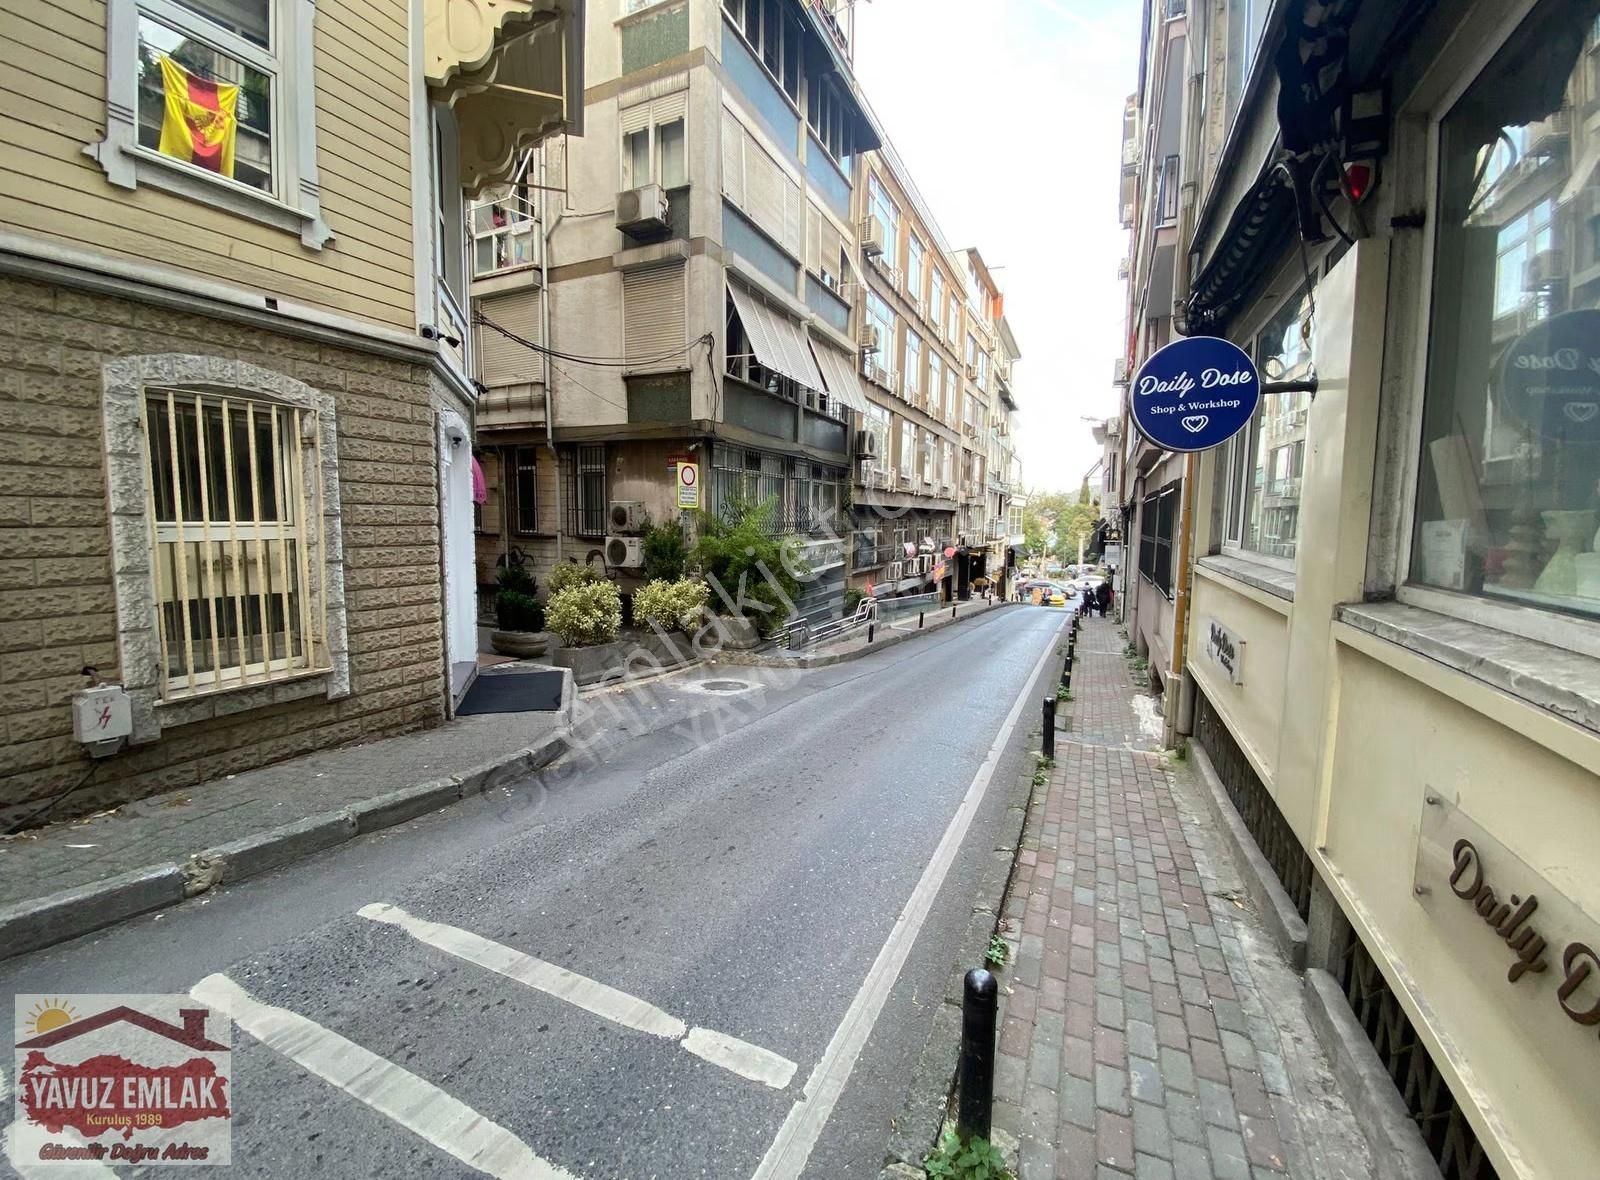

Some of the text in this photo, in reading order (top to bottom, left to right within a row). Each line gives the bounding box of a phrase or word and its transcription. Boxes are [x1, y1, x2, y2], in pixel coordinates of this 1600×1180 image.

[1140, 367, 1252, 398] Daily Dose
[1150, 398, 1241, 415] Shop & Workshop
[1449, 838, 1548, 983] Daily
